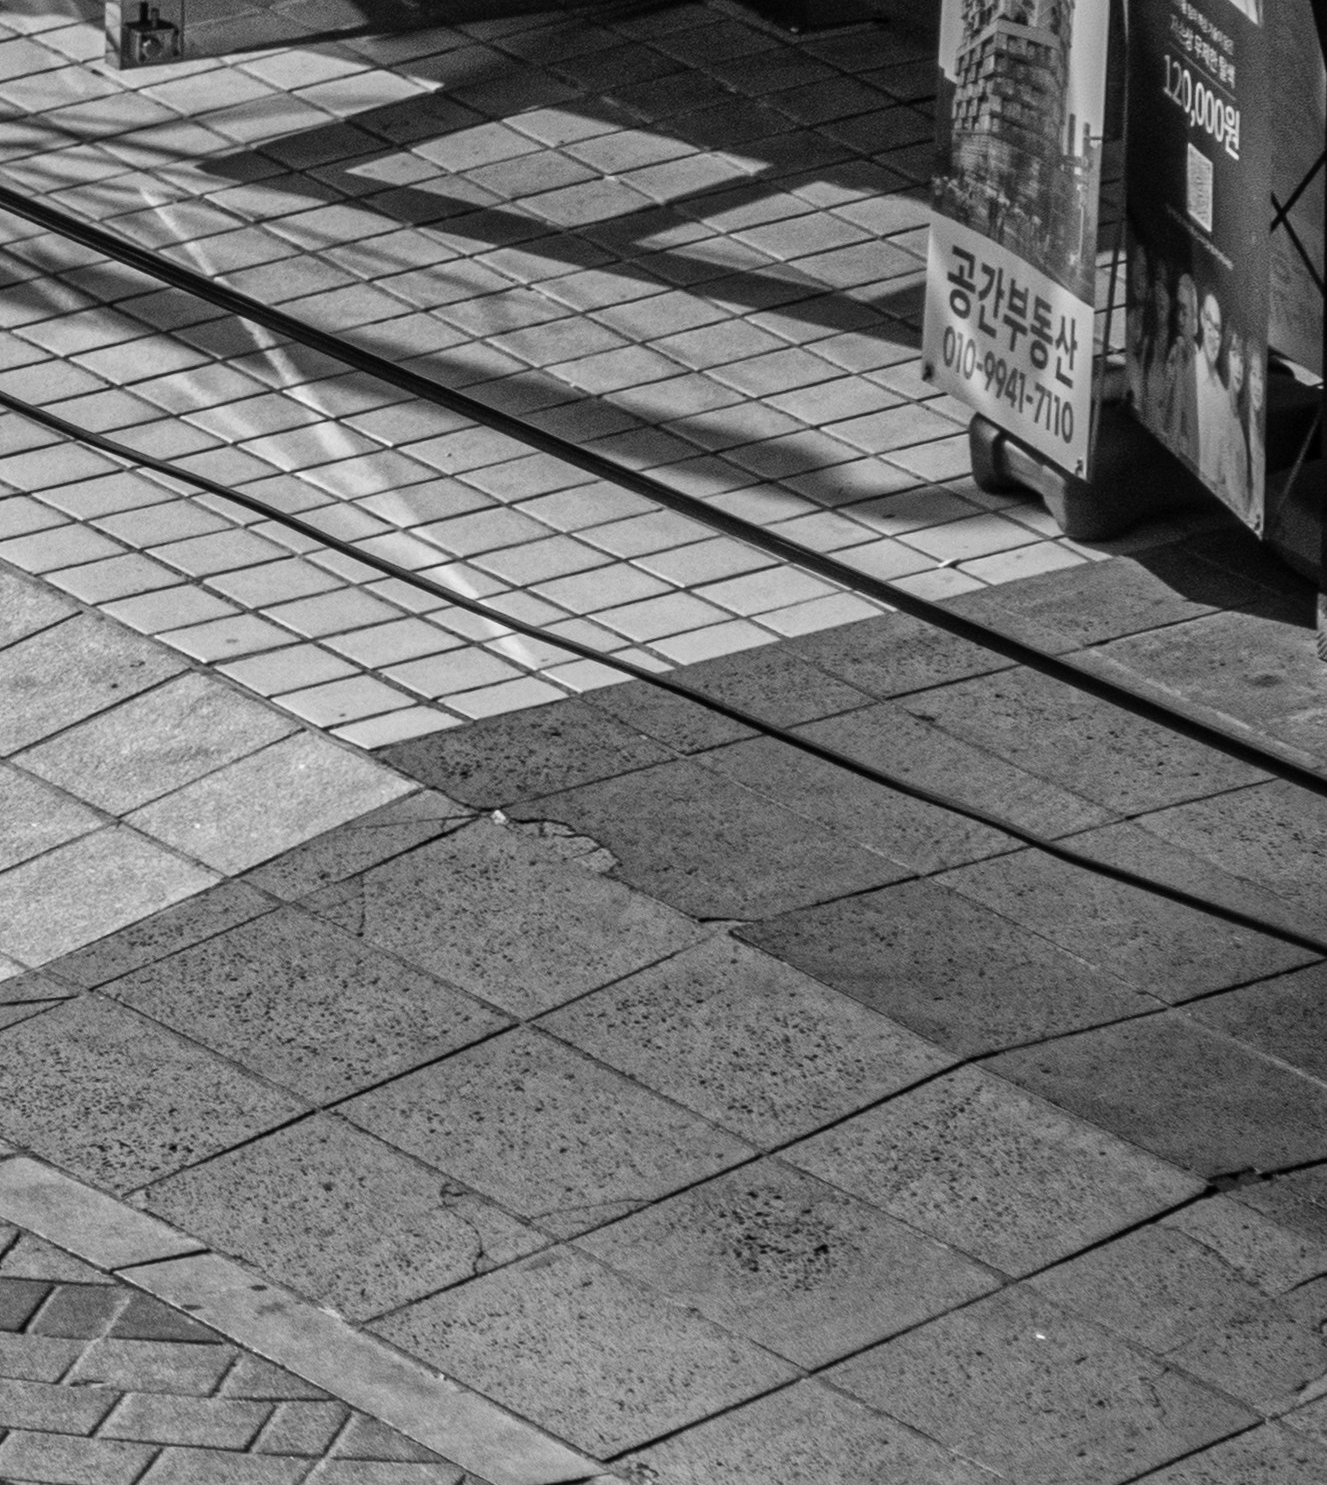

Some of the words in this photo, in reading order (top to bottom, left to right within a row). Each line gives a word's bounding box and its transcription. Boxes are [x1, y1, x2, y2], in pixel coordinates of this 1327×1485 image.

[1163, 54, 1240, 161] 120,000원
[947, 245, 1077, 389] 공간부동산
[943, 325, 1074, 444] 010-9941-7110
